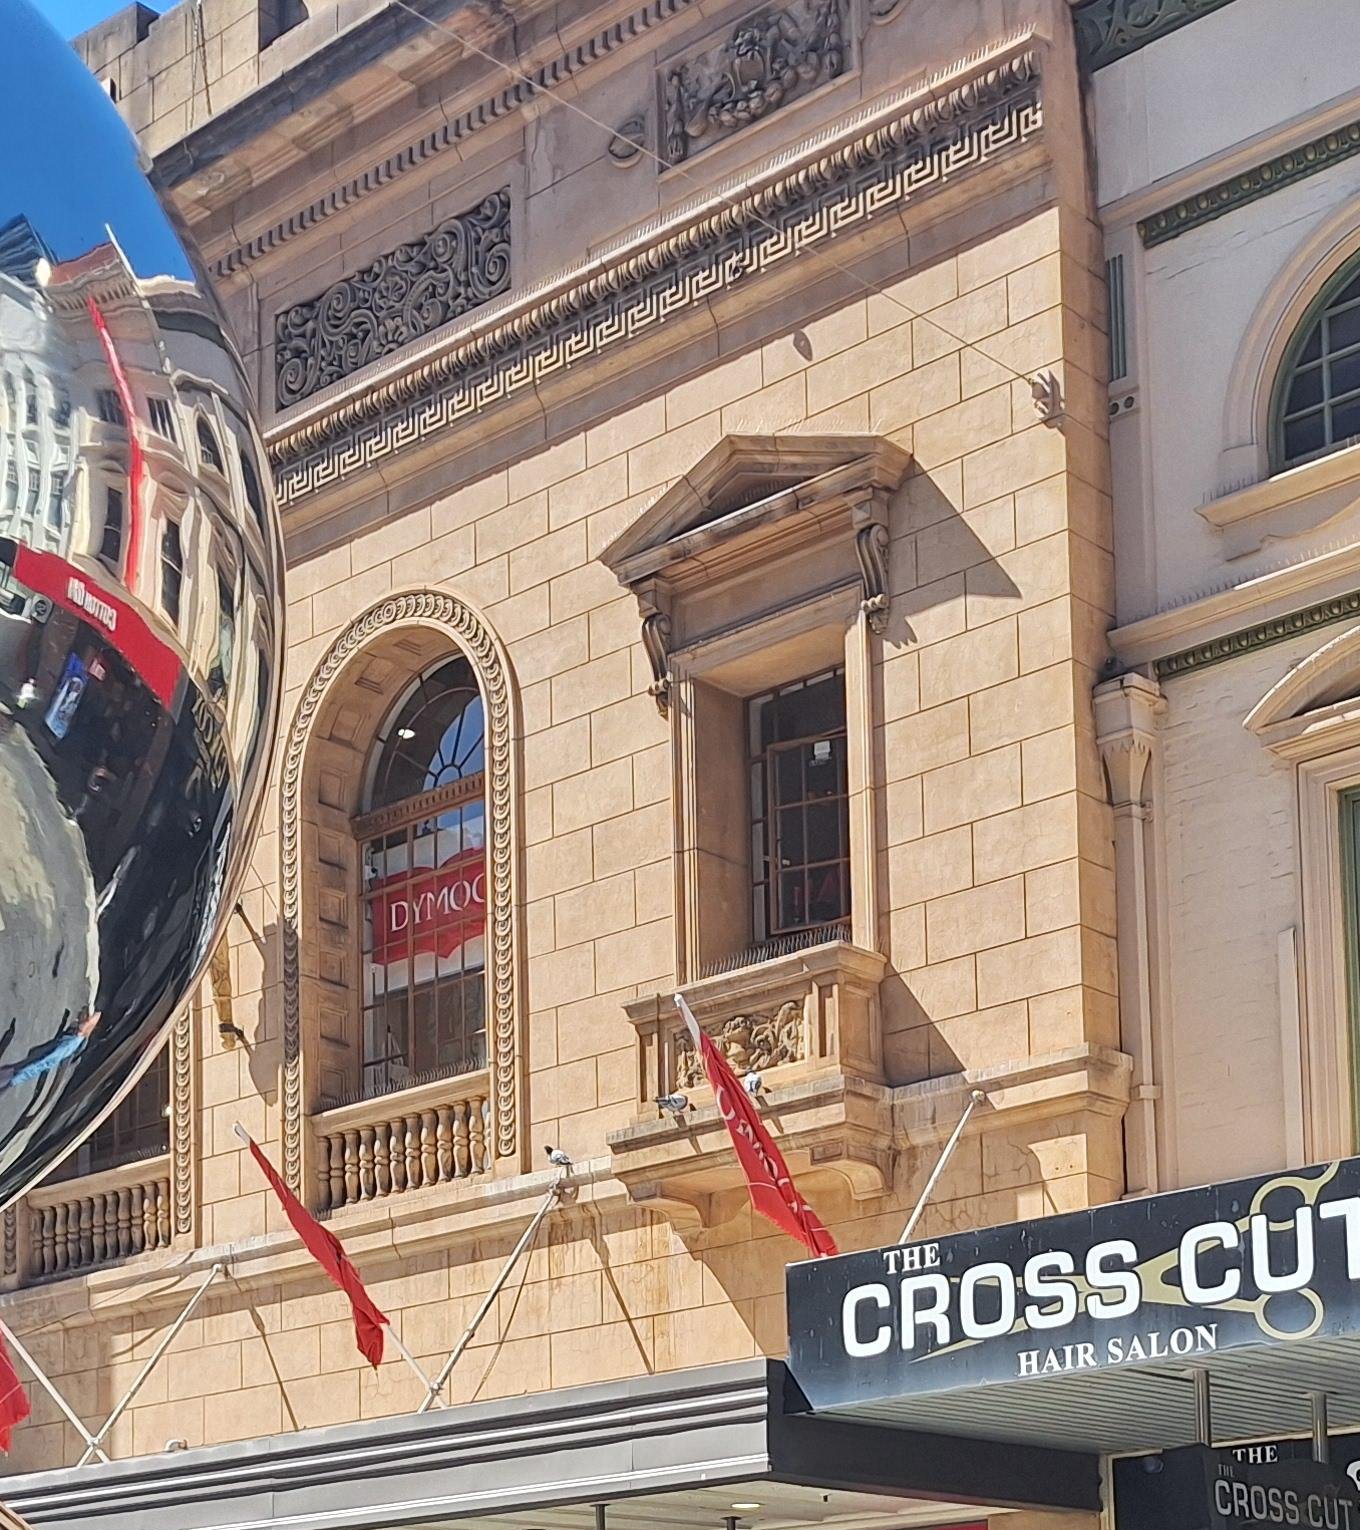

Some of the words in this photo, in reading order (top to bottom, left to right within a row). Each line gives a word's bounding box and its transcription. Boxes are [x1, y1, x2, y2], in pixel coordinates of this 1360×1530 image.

[391, 873, 485, 932] DYMOC
[883, 1242, 941, 1276] THE
[842, 1239, 1141, 1359] CROSS
[1017, 1342, 1098, 1378] HAIR
[1106, 1323, 1219, 1366] SALON
[1217, 1464, 1235, 1478] THE
[1233, 1445, 1278, 1464] THE
[1214, 1479, 1300, 1525] CROSS
